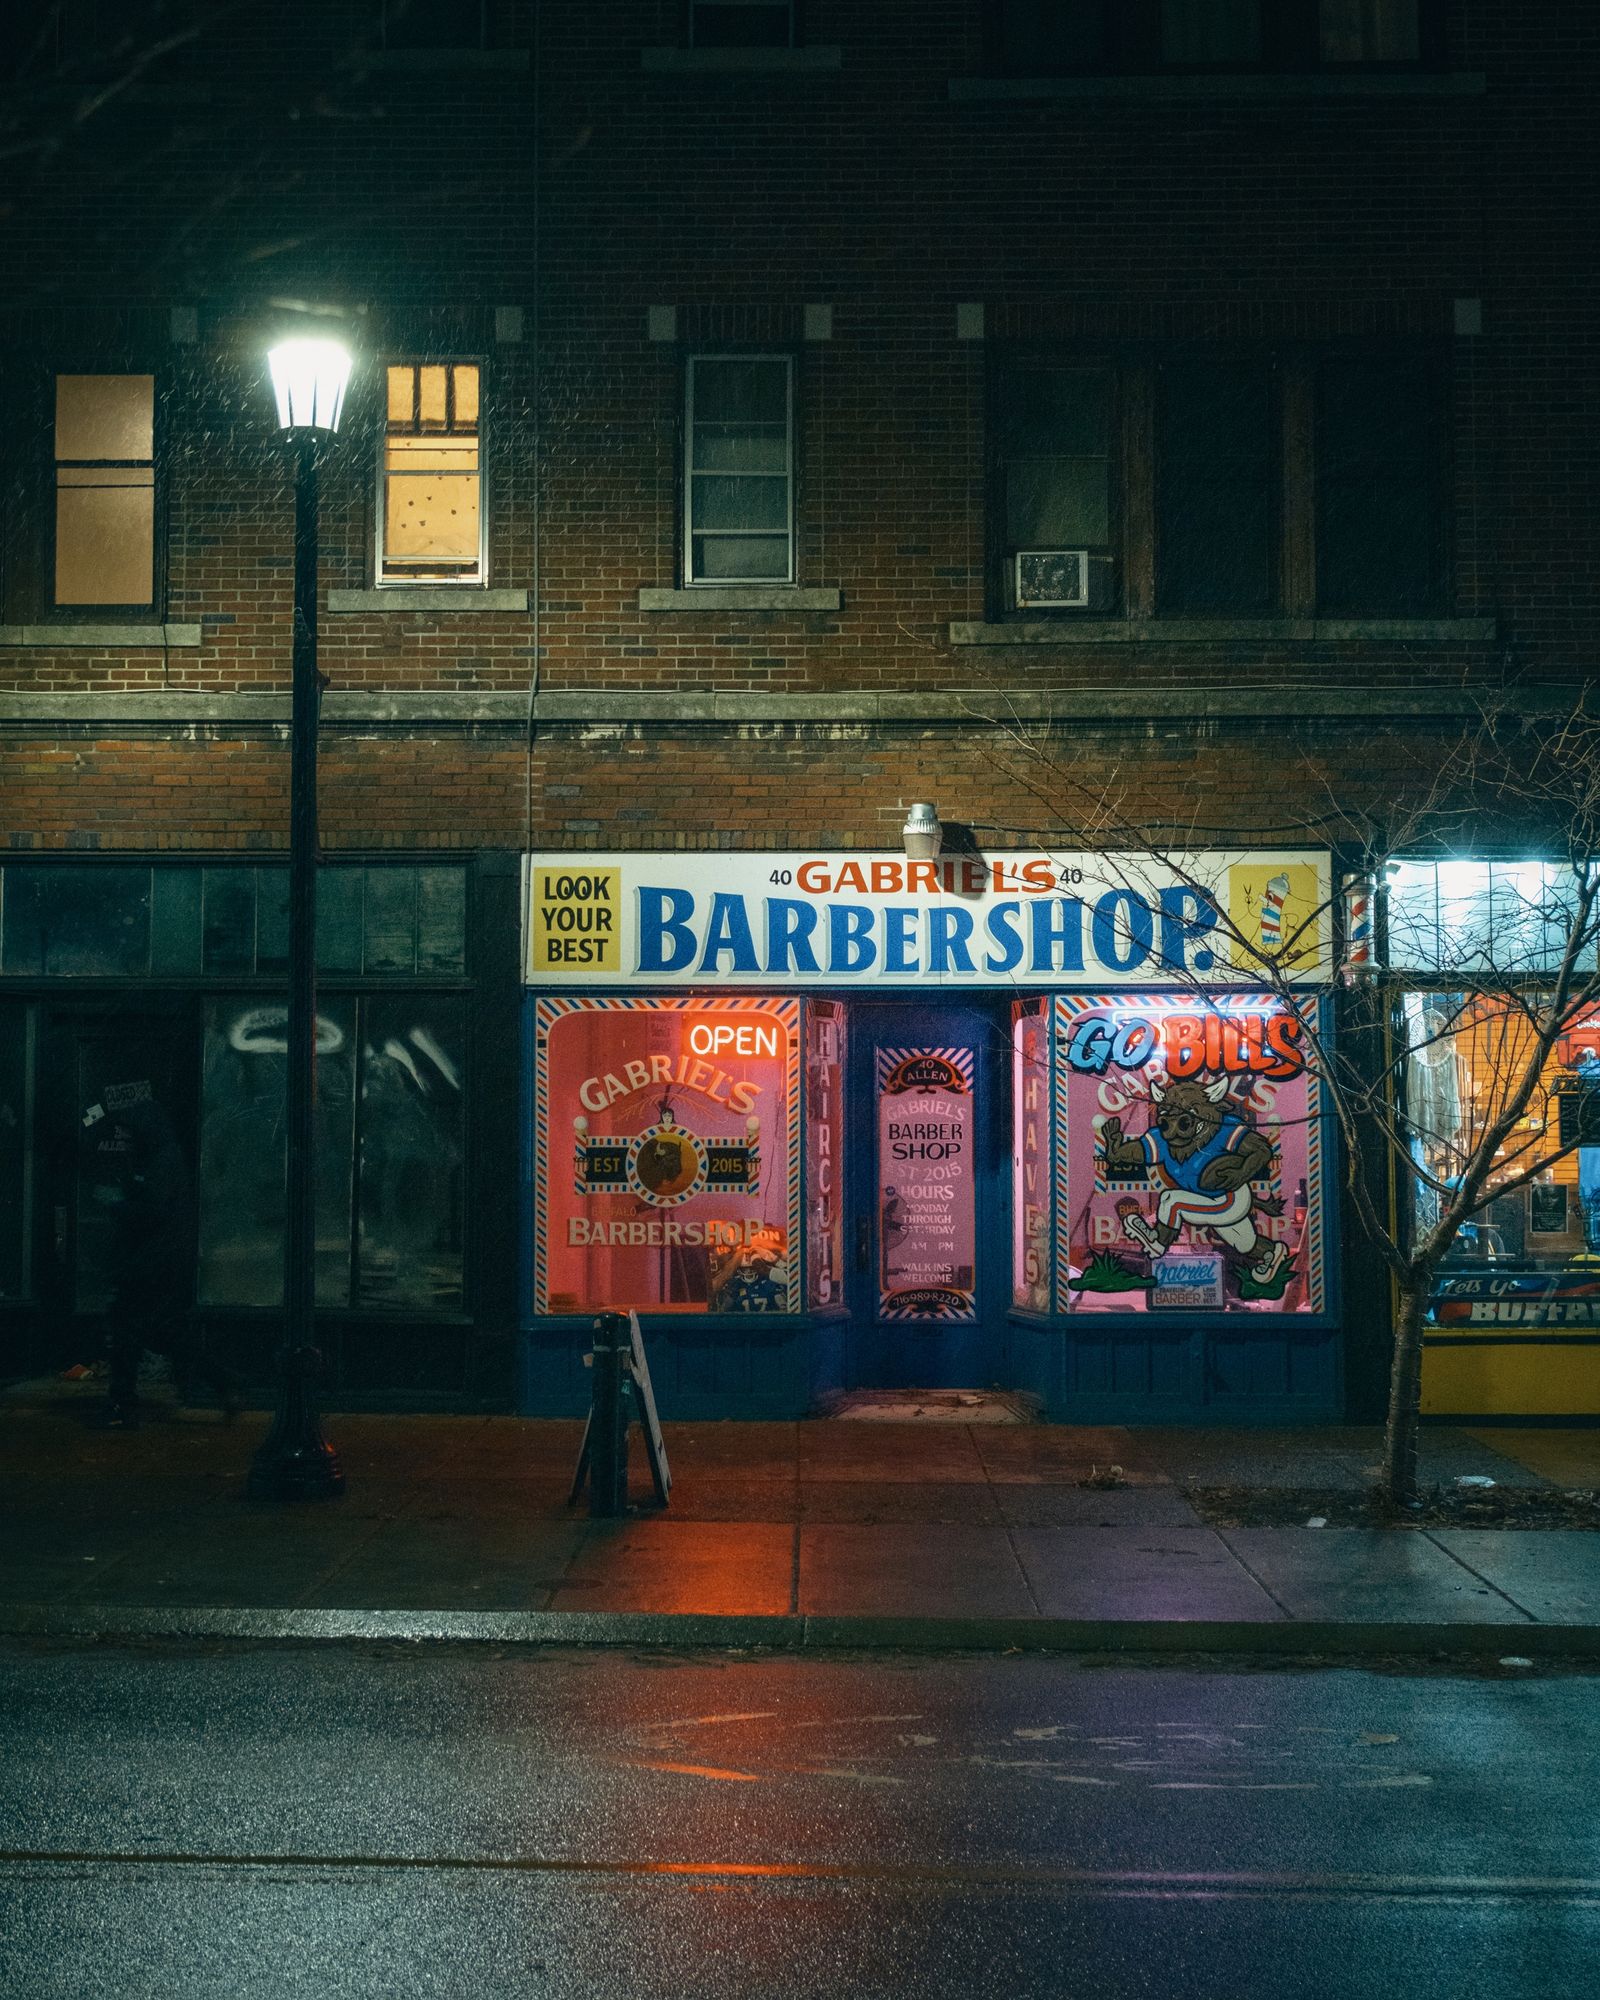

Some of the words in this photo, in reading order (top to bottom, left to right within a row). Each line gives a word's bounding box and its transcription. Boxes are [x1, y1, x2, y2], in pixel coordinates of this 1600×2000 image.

[769, 869, 792, 886] 40
[796, 860, 1056, 894] GABRIEL'S
[1060, 868, 1082, 885] 40
[545, 876, 610, 900] LOOK
[542, 906, 612, 932] YOUR
[547, 938, 608, 963] BEST
[690, 1024, 777, 1056] OPEN
[1067, 1017, 1156, 1076] GO
[1162, 1012, 1304, 1084] BILLS
[919, 1060, 935, 1069] 40
[579, 1054, 763, 1114] GABRIEL'S
[907, 1070, 949, 1082] ALLEN
[886, 1099, 967, 1121] GABRIEL'S
[888, 1123, 963, 1140] BARBER
[892, 1142, 962, 1160] SHOP
[594, 1158, 620, 1173] EST
[711, 1158, 743, 1173] 2015
[818, 1022, 832, 1303] HAIRCUTS
[923, 1161, 962, 1181] 2015
[901, 1185, 955, 1200] HOURS
[905, 1203, 949, 1213] MONDAY
[901, 1214, 952, 1224] THROUGH
[568, 1216, 765, 1247] BARBERSHOP
[902, 1273, 953, 1283] WELCOME
[1155, 1293, 1200, 1304] BARBER
